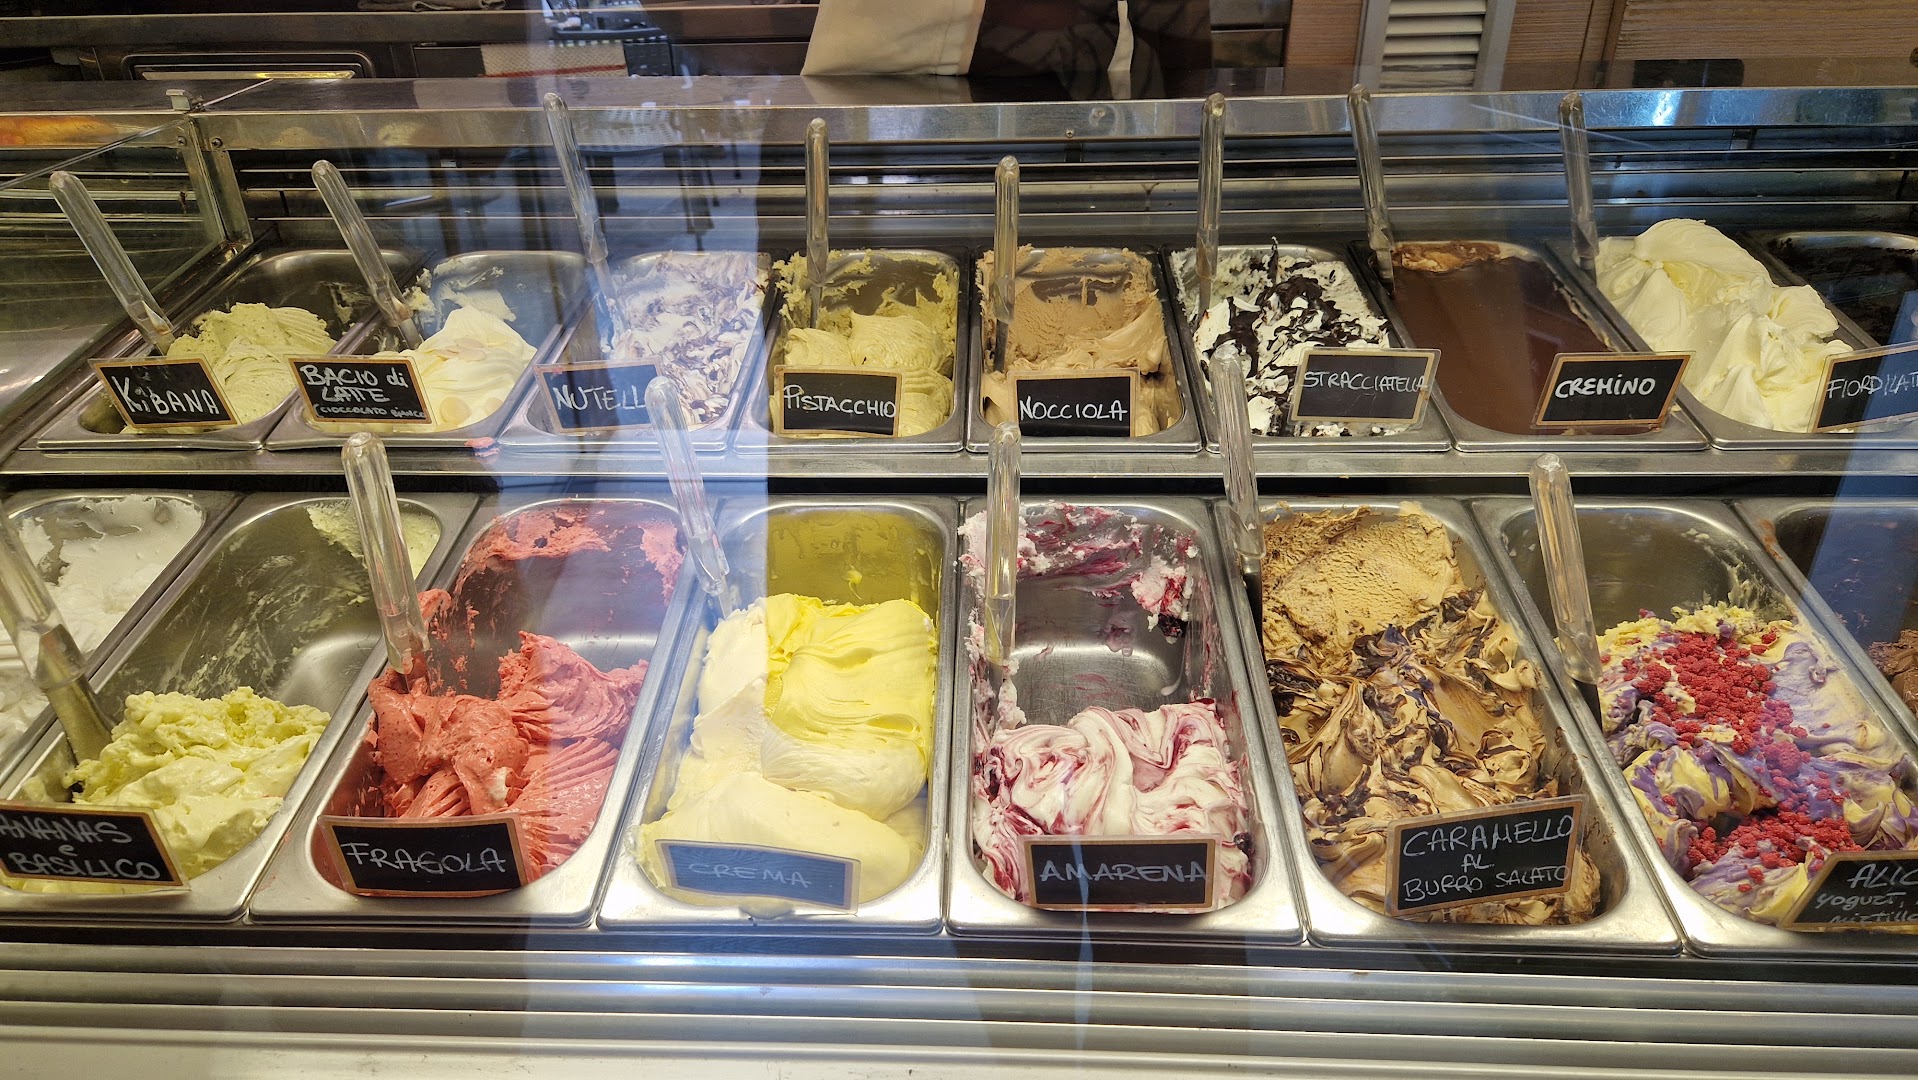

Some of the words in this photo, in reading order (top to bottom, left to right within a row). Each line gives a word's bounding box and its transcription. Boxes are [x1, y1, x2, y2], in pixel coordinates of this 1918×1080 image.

[300, 364, 379, 387] BACIO
[1301, 371, 1429, 393] STRACCIATELLA
[321, 386, 391, 403] LATTE
[552, 384, 647, 411] NUTELL
[1019, 395, 1129, 421] NOCCIOLA
[0, 814, 133, 844] ANANAS
[1403, 815, 1575, 857] CARAMELLO
[8, 852, 161, 880] BASILICO
[340, 842, 506, 875] FRAGOLA
[1039, 860, 1208, 883] AMARENA
[1461, 853, 1491, 873] AL
[688, 863, 813, 888] CREMA
[1403, 875, 1483, 902] BURRO
[1495, 865, 1571, 888] SALATO
